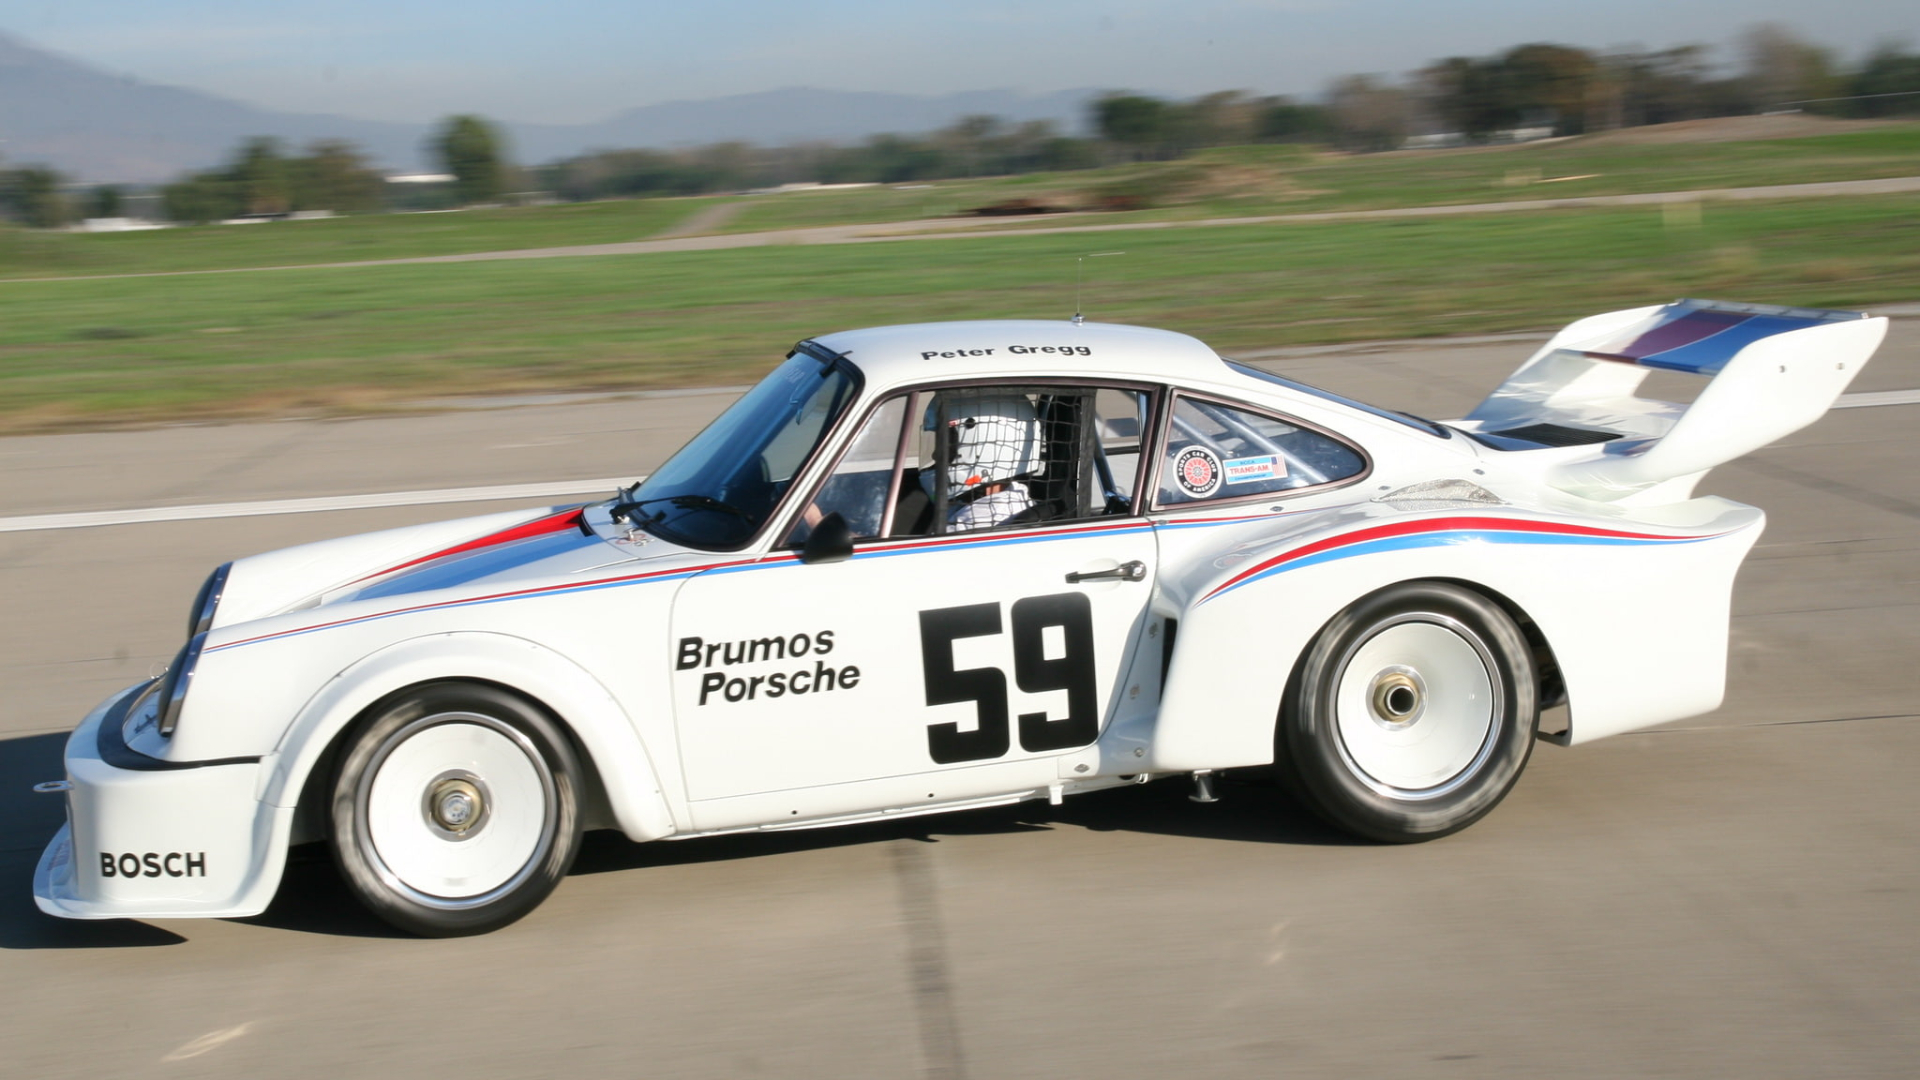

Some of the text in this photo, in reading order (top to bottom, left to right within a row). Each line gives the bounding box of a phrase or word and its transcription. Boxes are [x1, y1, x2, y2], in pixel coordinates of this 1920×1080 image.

[921, 345, 1092, 361] Peter Gregg
[1178, 453, 1191, 476] SPORTS
[1206, 456, 1217, 472] CLUB
[1230, 465, 1269, 474] TRANS-AM
[1193, 478, 1216, 492] AMERICA
[675, 629, 835, 671] Brumos
[698, 660, 861, 706] Porsche
[918, 591, 1099, 765] 59
[100, 852, 206, 879] BOSCH
